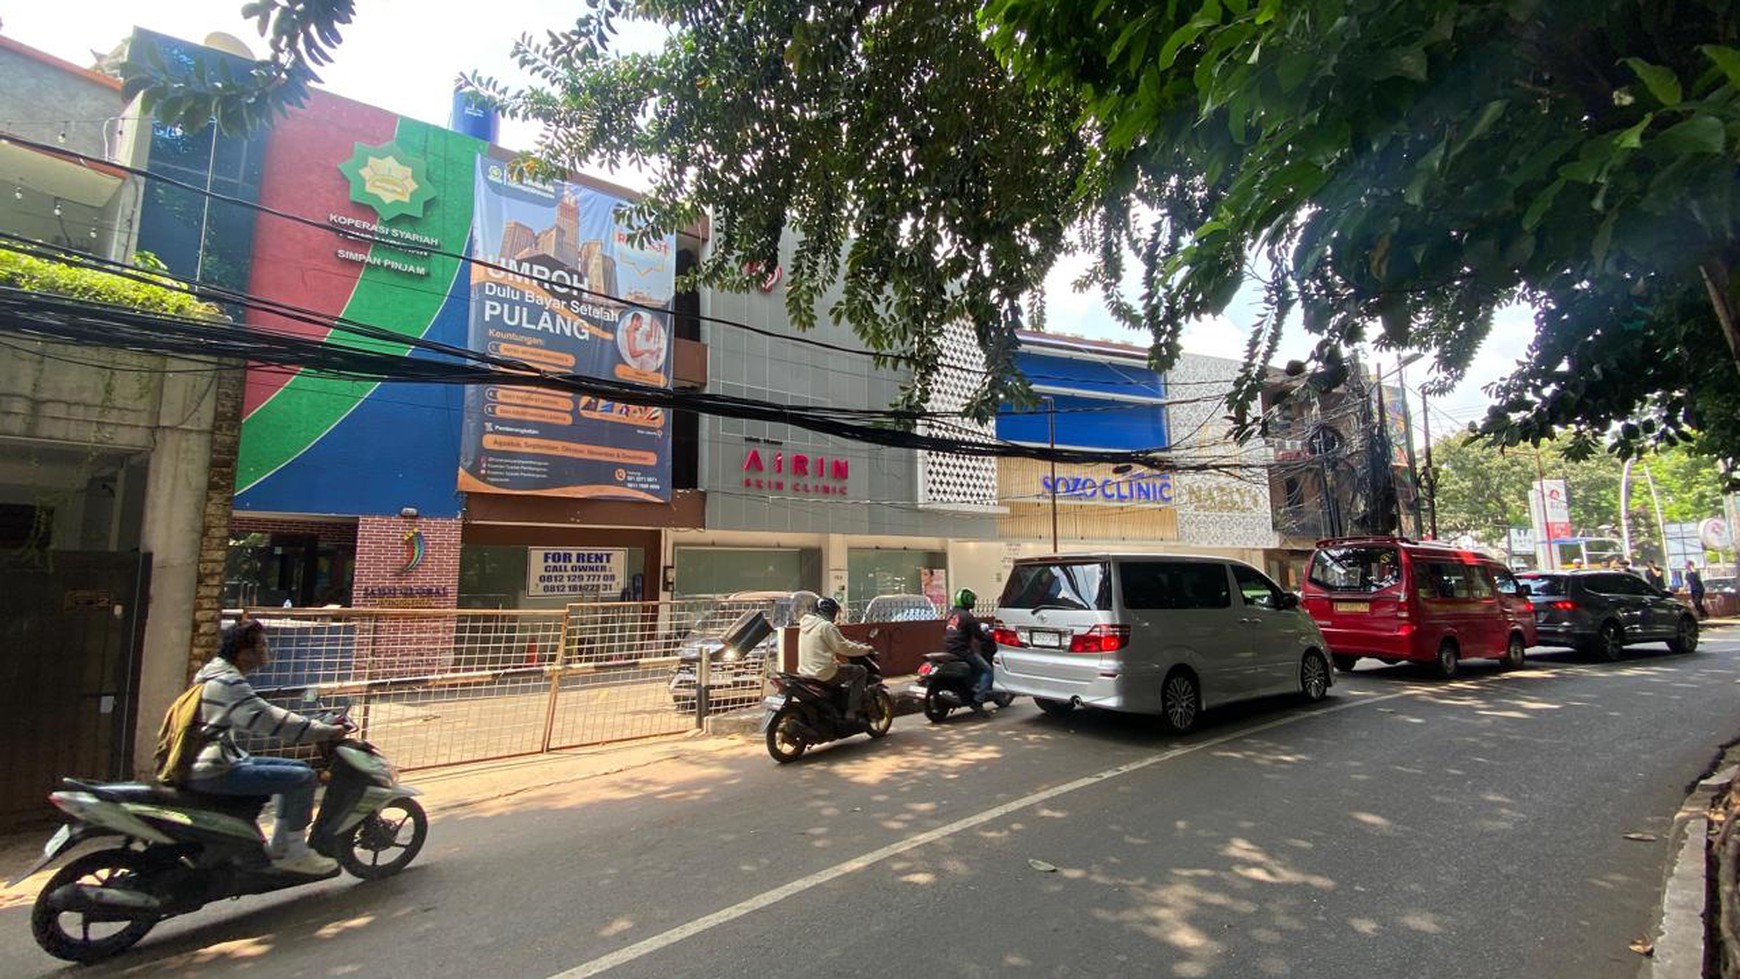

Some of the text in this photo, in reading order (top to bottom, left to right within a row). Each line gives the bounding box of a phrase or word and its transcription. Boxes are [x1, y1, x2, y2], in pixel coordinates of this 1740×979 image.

[329, 213, 389, 234] KOPERASI
[391, 228, 438, 246] SYARIAH
[337, 249, 425, 276] SIMPAN PINJAM
[486, 254, 590, 300] UMROH
[485, 283, 618, 323] Dulu Bayar Setelah
[484, 300, 590, 342] PULANG
[791, 483, 848, 496] CLINIC
[1101, 478, 1173, 502] CLINIC
[543, 552, 613, 563] FOR RENT
[544, 565, 569, 573] CALL
[539, 574, 565, 583] 0812
[586, 574, 602, 583] 777
[543, 584, 566, 593] 0812
